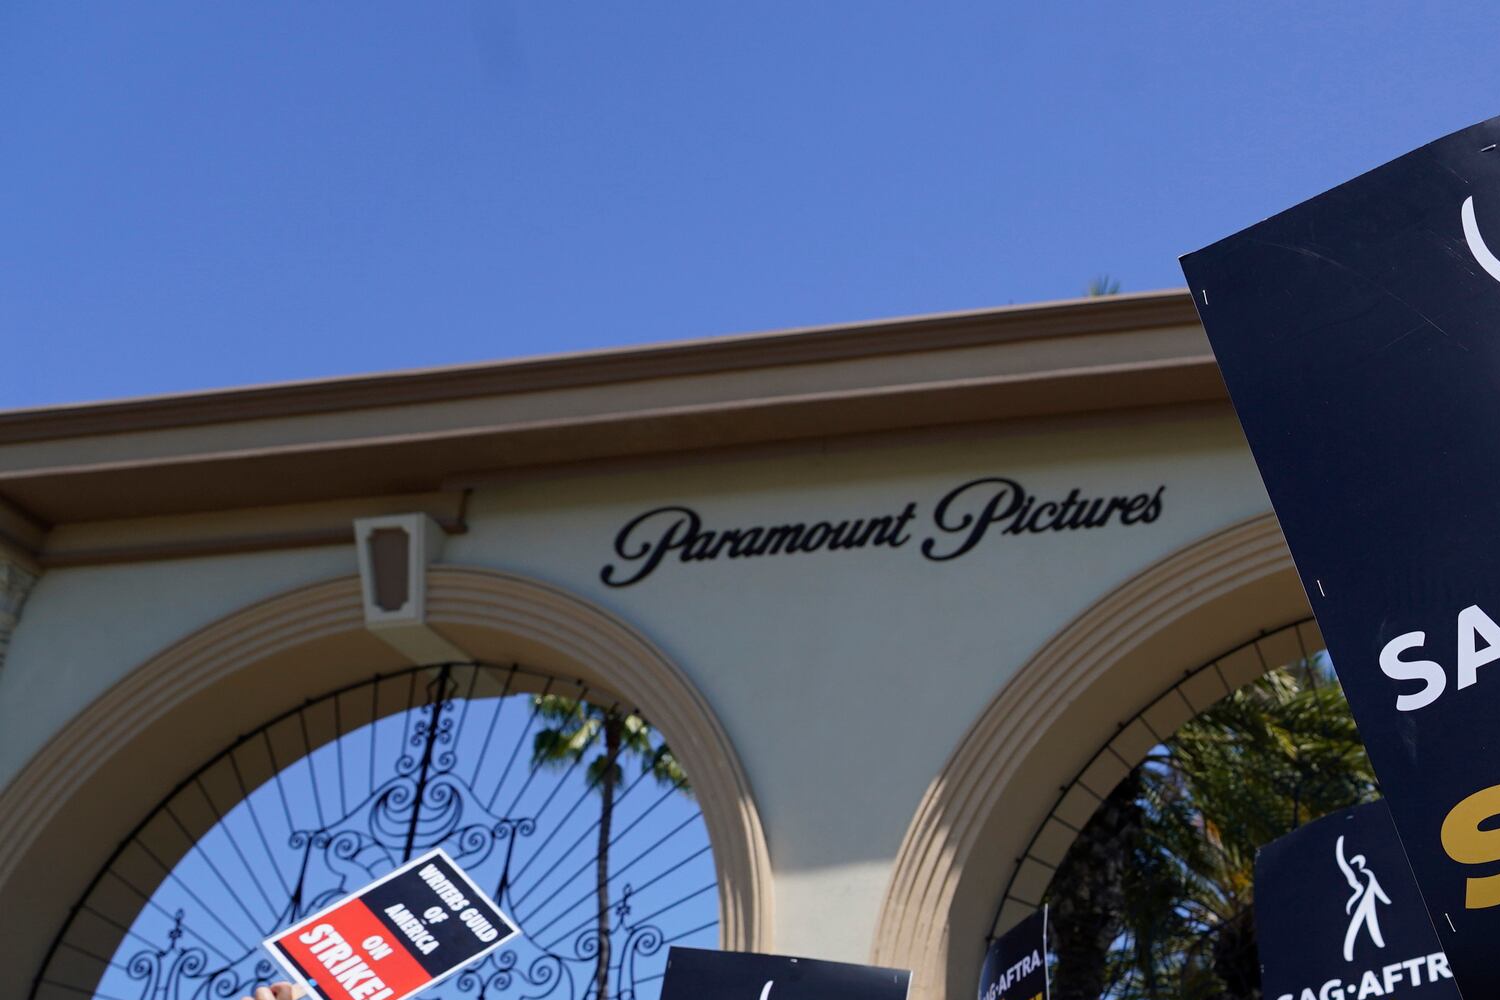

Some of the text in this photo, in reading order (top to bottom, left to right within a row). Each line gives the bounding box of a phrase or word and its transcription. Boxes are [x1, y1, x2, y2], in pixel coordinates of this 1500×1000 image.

[600, 477, 1166, 588] Paramount Pictures
[384, 903, 440, 955] AMERICA
[418, 863, 499, 943] WRITERS GUILD
[423, 906, 449, 925] OF
[361, 935, 393, 961] ON
